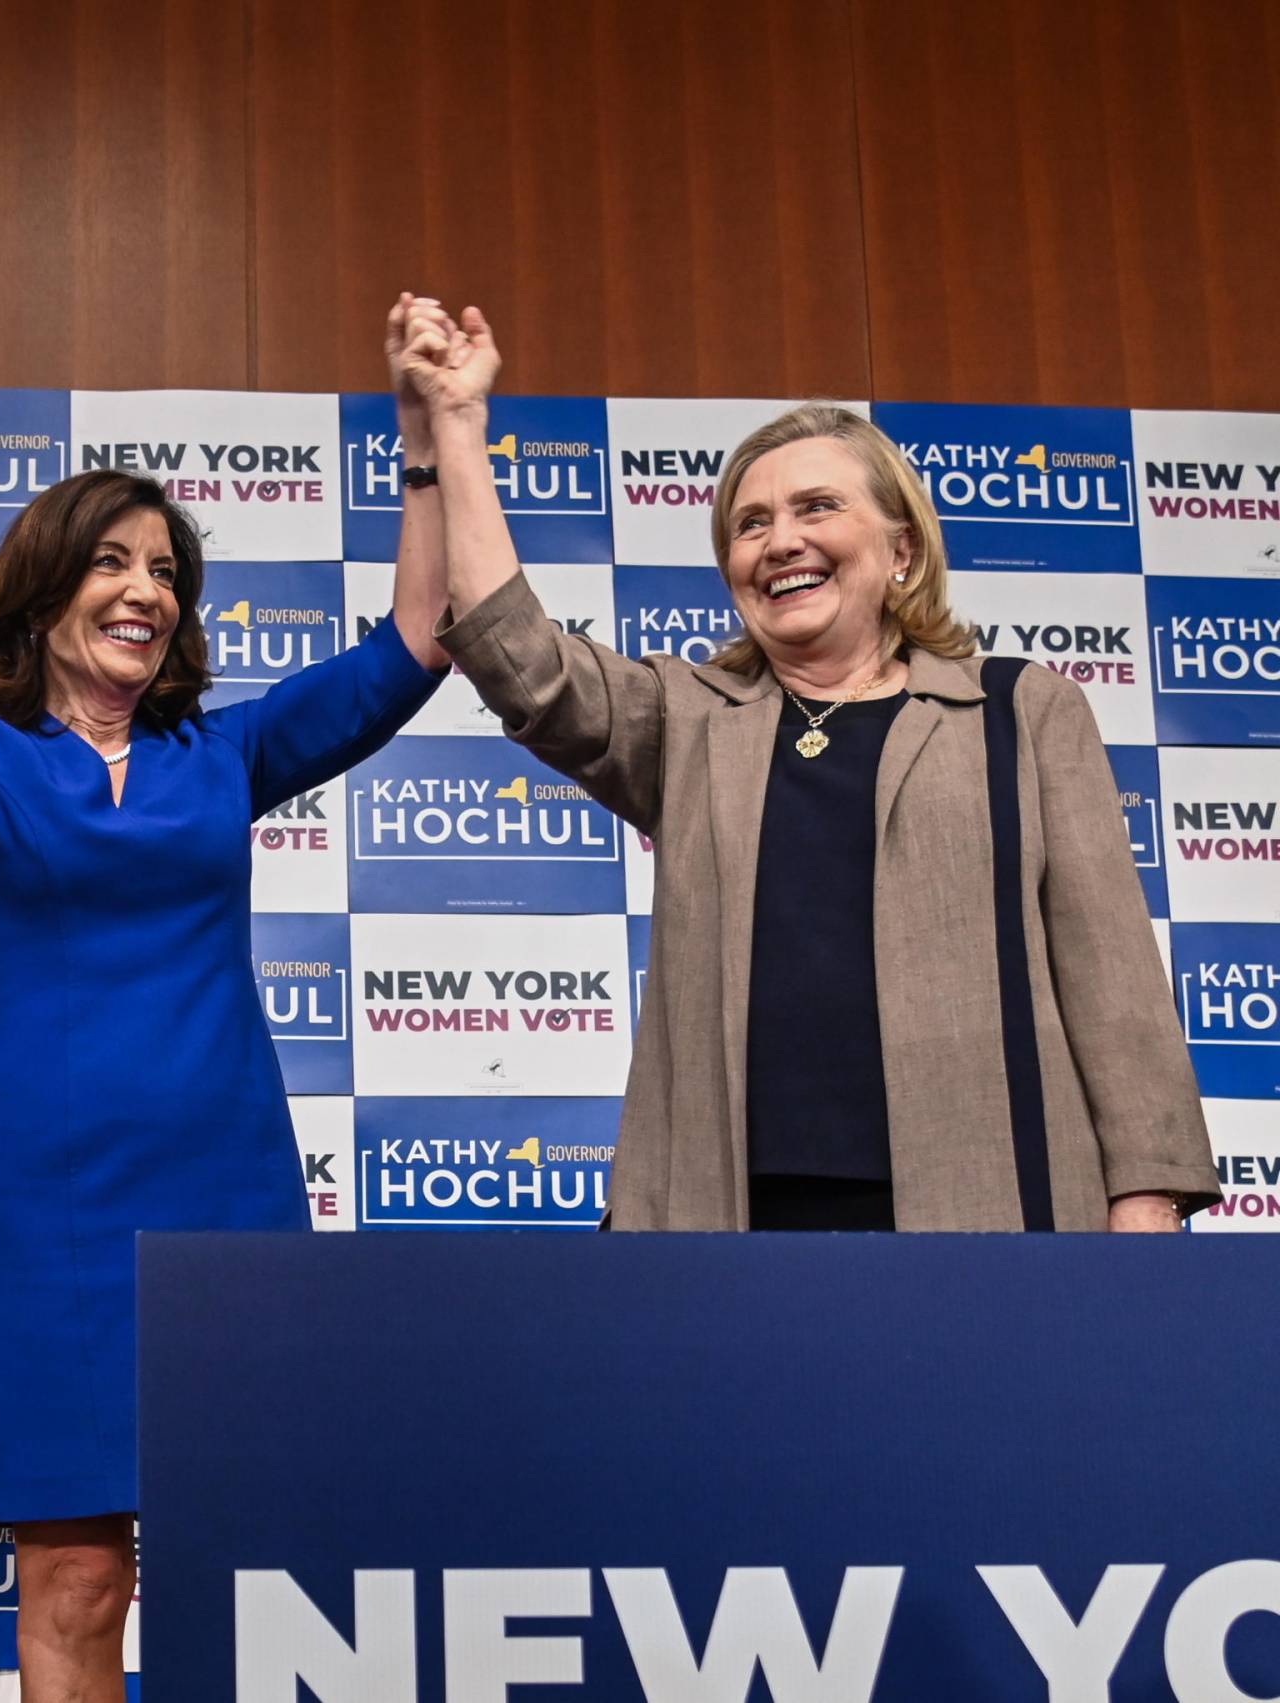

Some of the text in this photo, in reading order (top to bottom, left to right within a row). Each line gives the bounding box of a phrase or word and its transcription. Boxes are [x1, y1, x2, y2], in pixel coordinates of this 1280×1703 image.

[82, 444, 321, 473] NEW YORK
[523, 442, 590, 457] GOVERNOR
[900, 443, 1117, 469] KATHY GOVERNOR
[621, 450, 725, 476] NEW
[1145, 462, 1245, 490] NEW
[232, 480, 323, 501] VOTE
[624, 484, 714, 506] WOM
[1148, 496, 1280, 520] WOMEN
[256, 608, 324, 625] GOVERNOR
[1171, 616, 1280, 641] KATHY
[217, 632, 324, 668] HUL
[1013, 625, 1132, 654] YORK
[1173, 644, 1280, 680] HOC
[373, 780, 593, 803] KATHY GOVERN
[373, 808, 605, 845] HOCHUL
[1173, 803, 1277, 830] NEW
[1177, 838, 1280, 862] WOME
[261, 961, 331, 979] GOVERNOR
[1200, 963, 1280, 988] KATH
[365, 970, 612, 1000] NEW YORK
[366, 1007, 615, 1032] WOMEN VOTE
[381, 1139, 502, 1165] KATHY
[381, 1169, 606, 1209] HOCHUL
[235, 1566, 905, 1703] NEW
